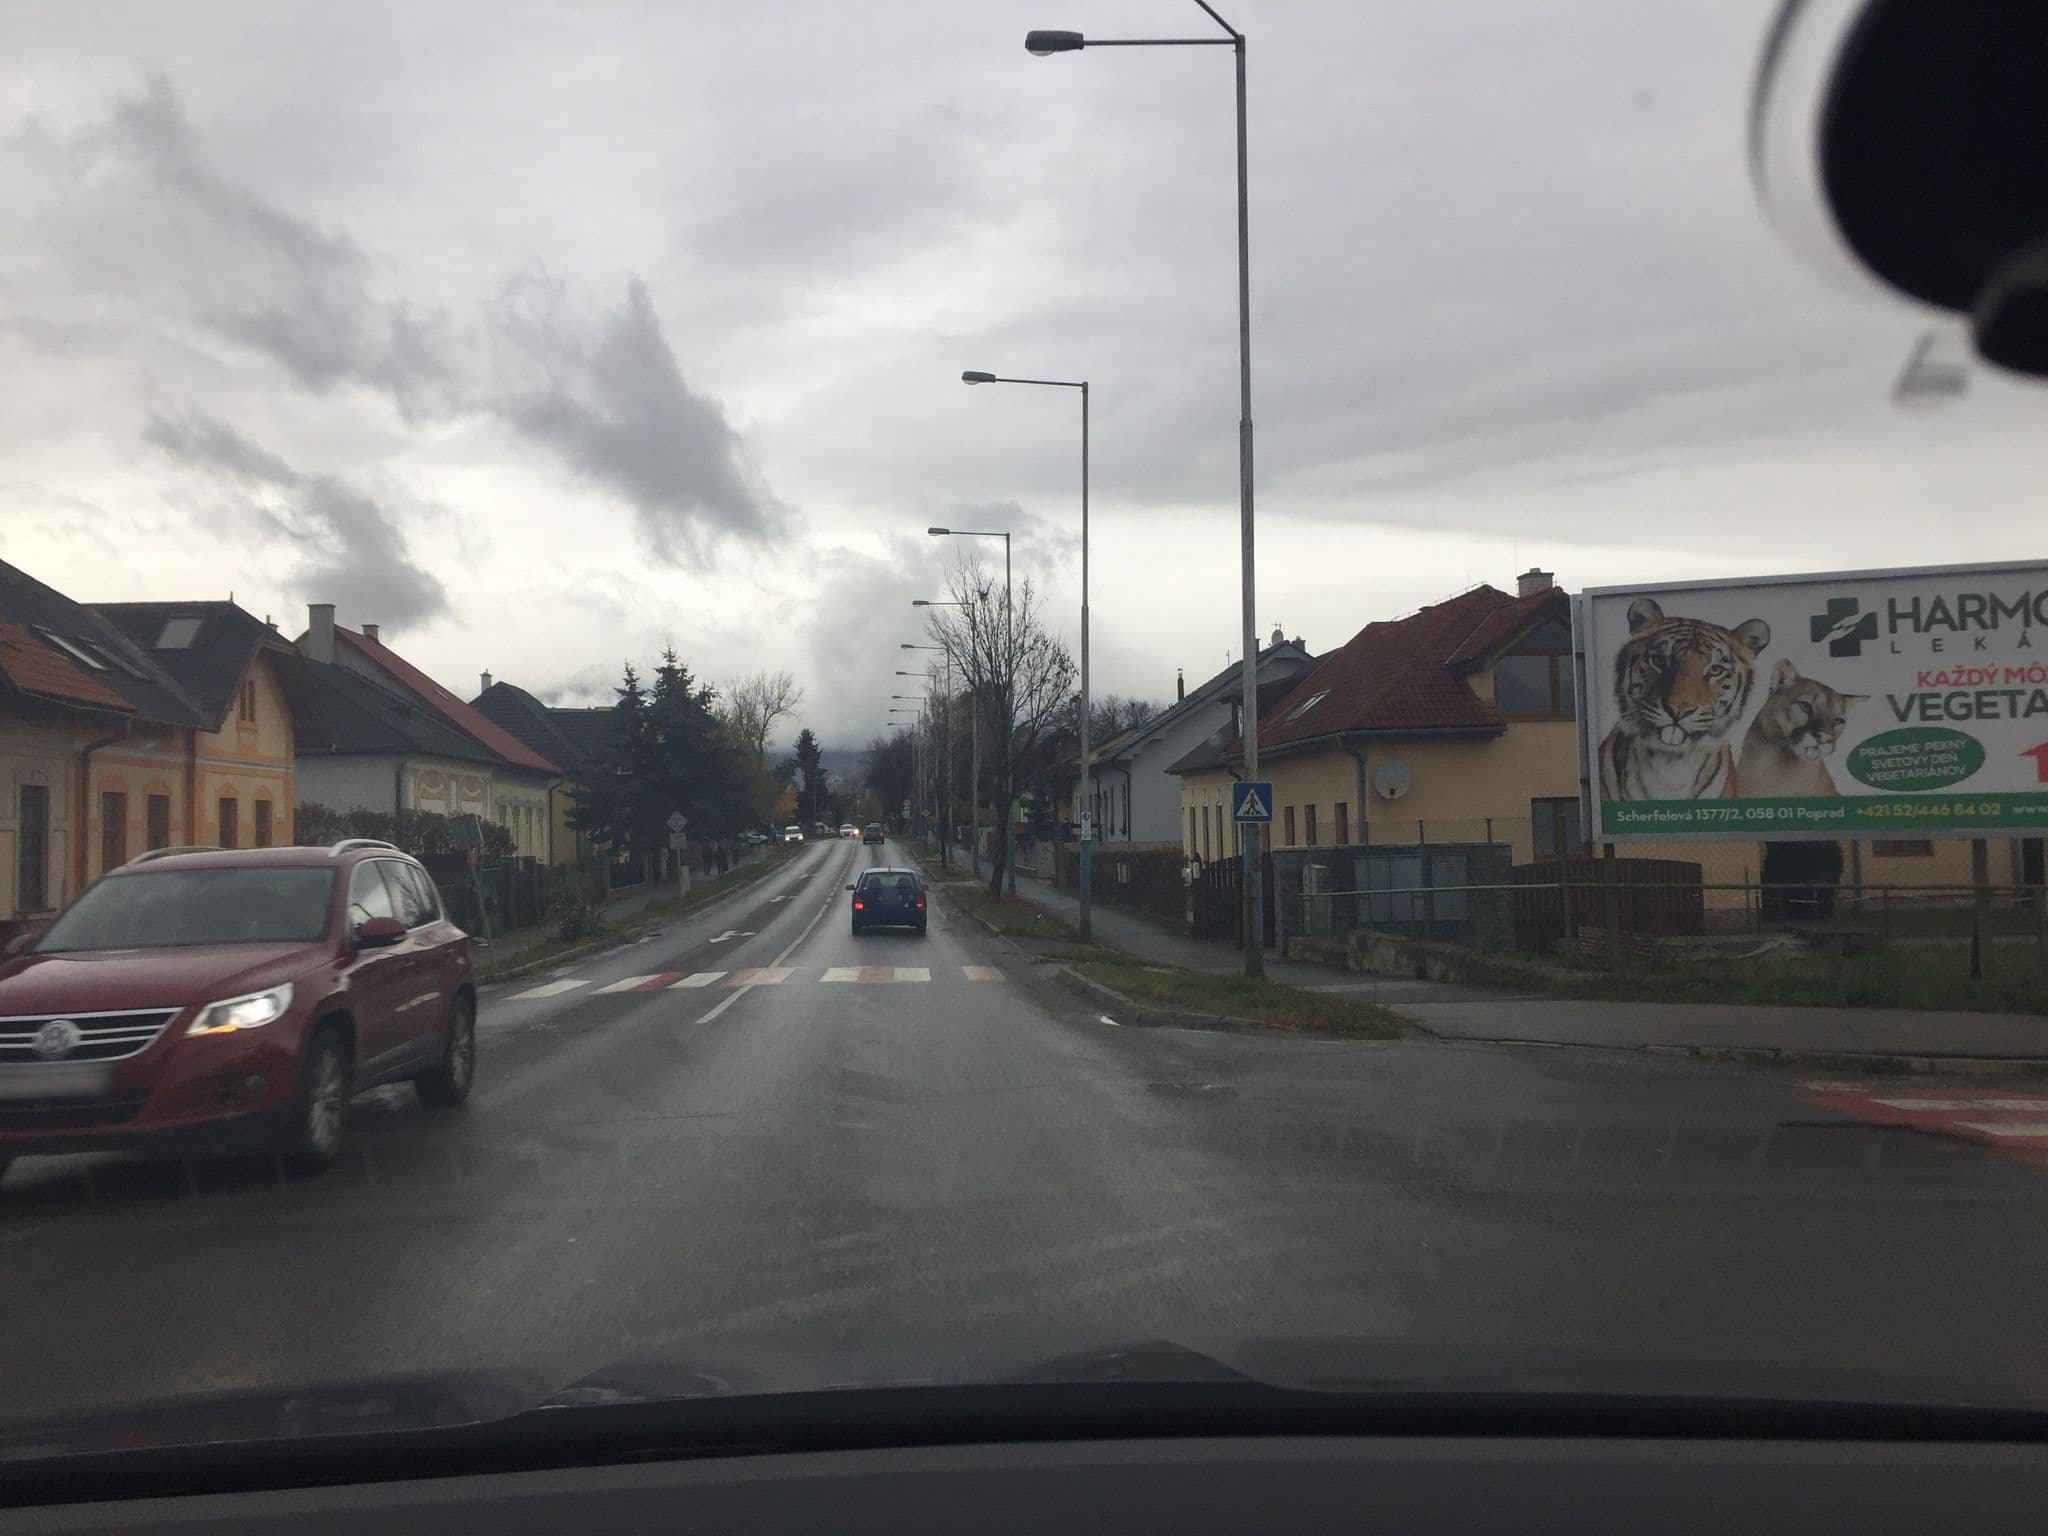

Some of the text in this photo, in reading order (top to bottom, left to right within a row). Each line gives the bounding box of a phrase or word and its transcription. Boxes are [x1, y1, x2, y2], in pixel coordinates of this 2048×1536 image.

[1918, 662, 2048, 688] KAŽDÝ MÔ
[1886, 688, 2048, 722] VEGETA
[1859, 743, 1921, 757] PRAJEME
[1616, 809, 1693, 822] Scherfelová
[1746, 807, 1775, 819] 058
[1777, 807, 1793, 819] 01
[1796, 805, 1845, 821] Poprad
[1855, 804, 1890, 817] +421
[1893, 803, 1950, 819] 52/446
[1978, 803, 2001, 816] 02
